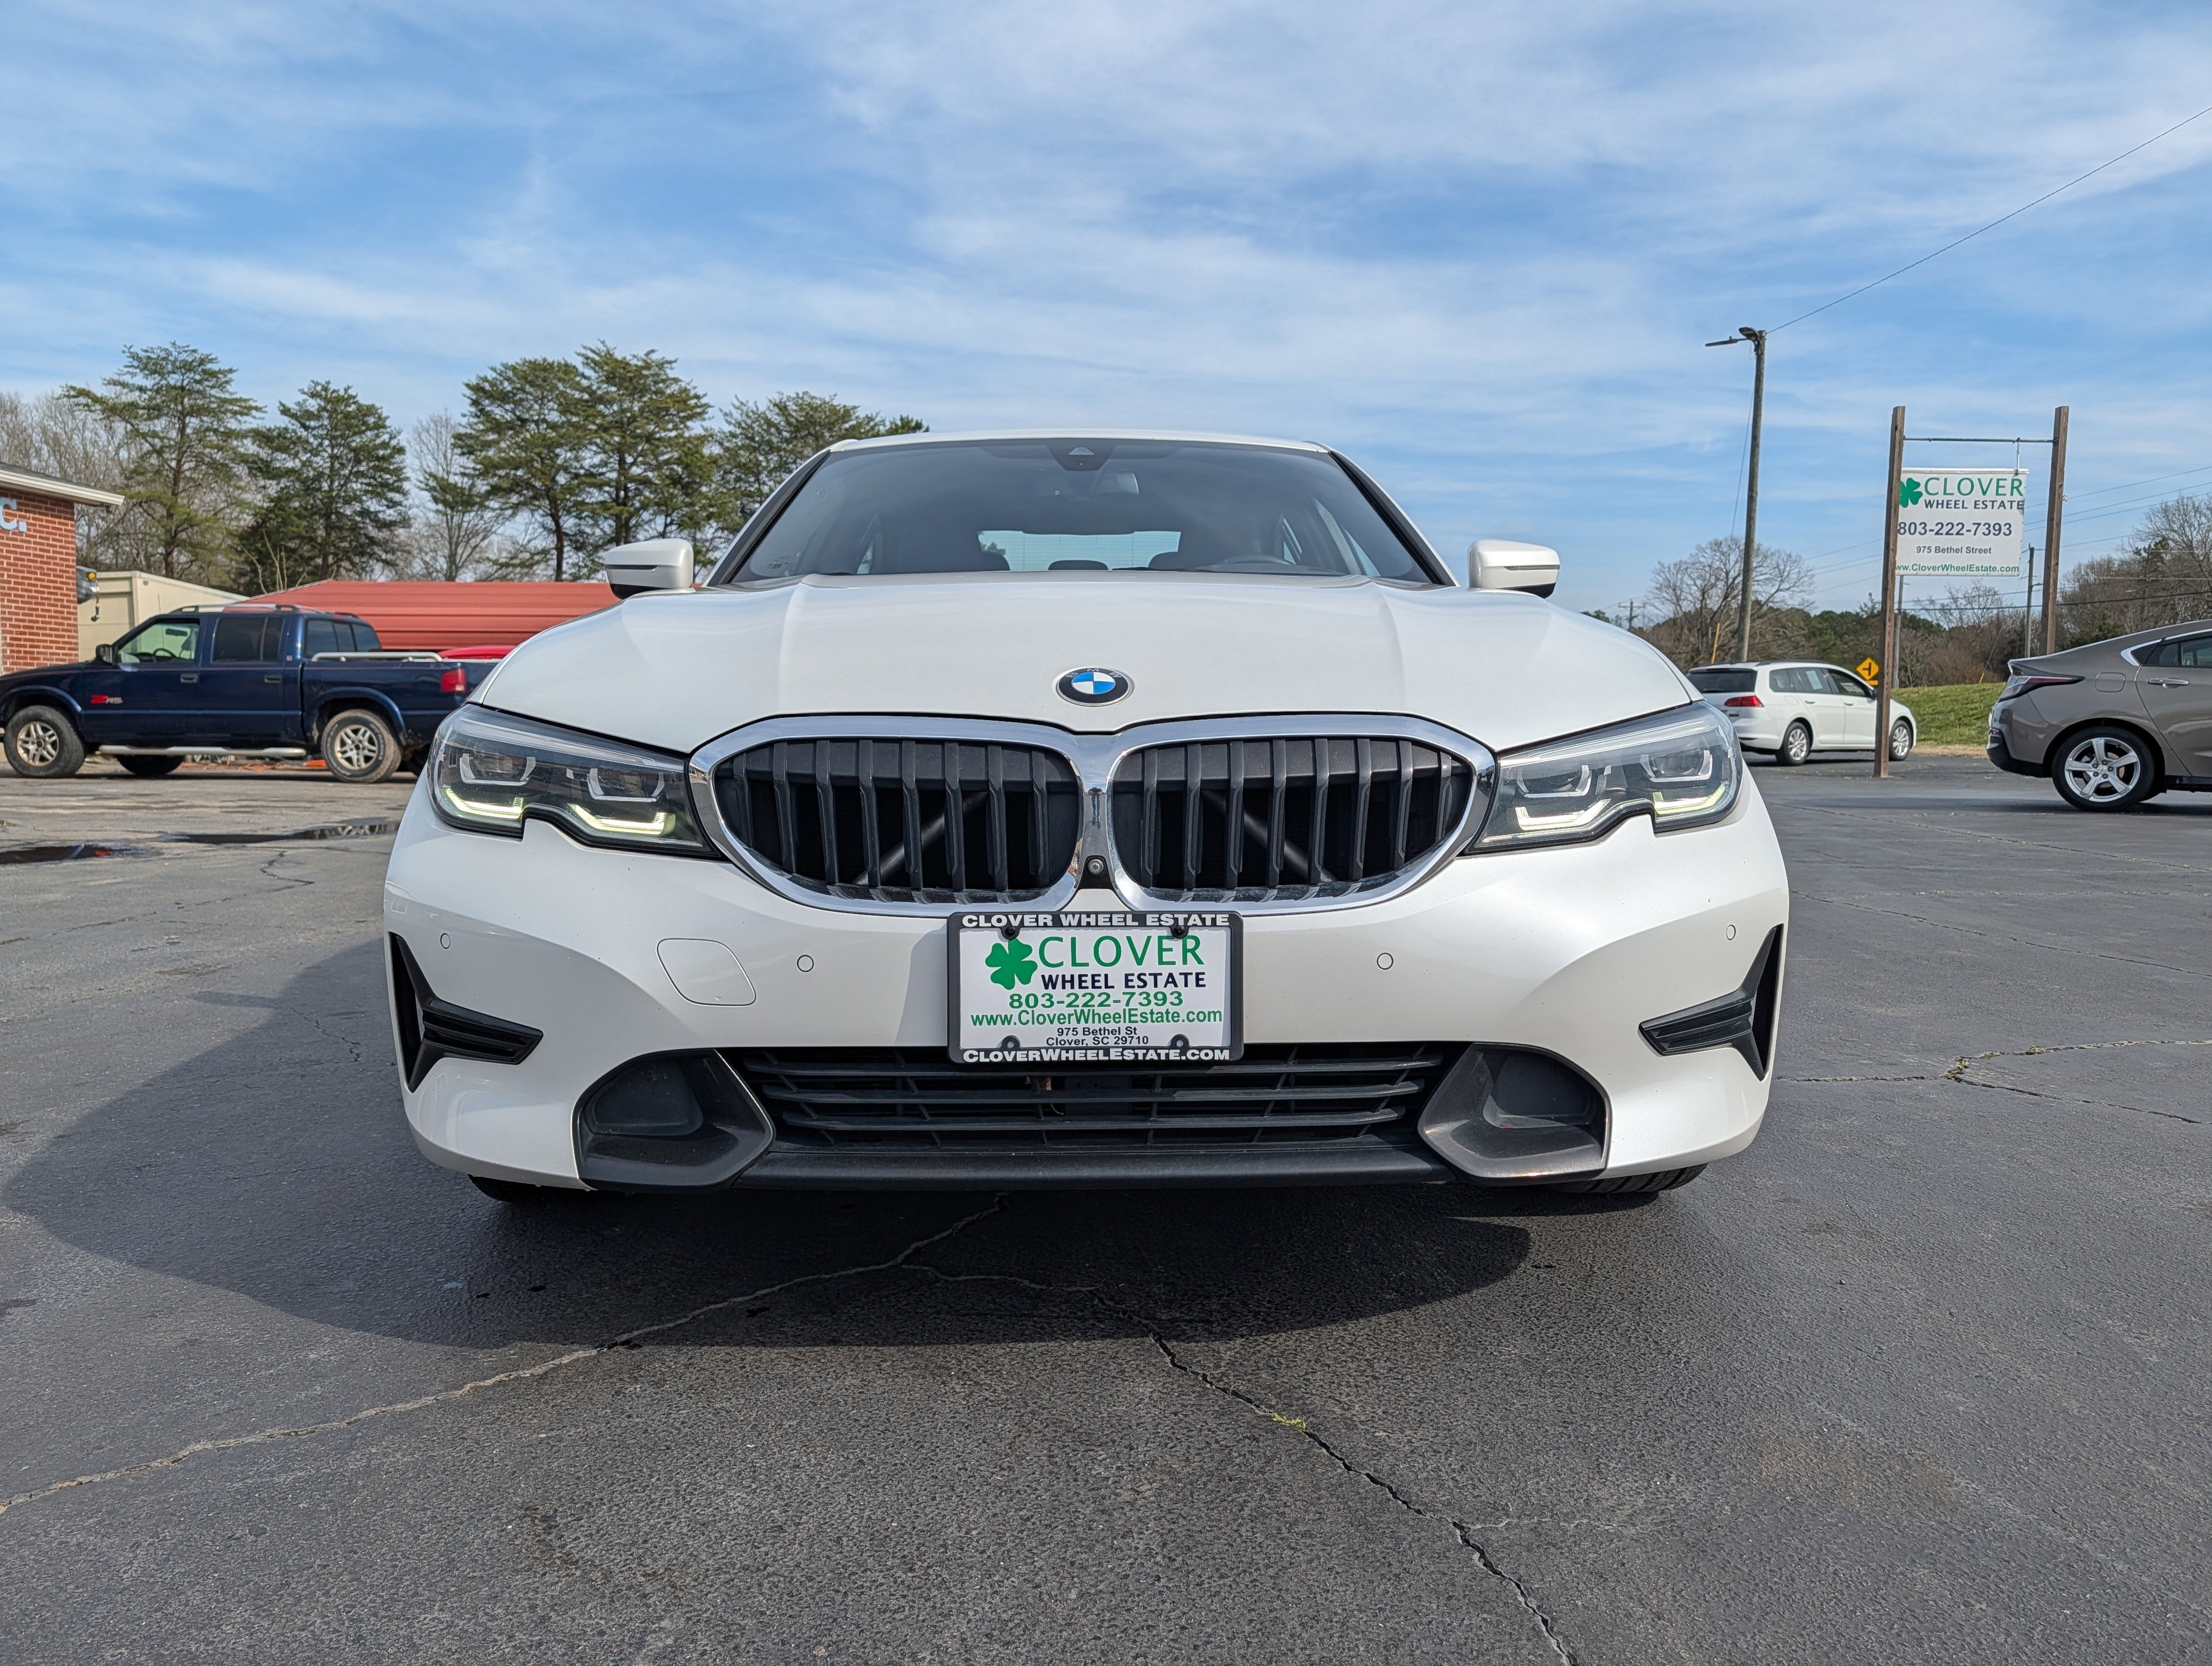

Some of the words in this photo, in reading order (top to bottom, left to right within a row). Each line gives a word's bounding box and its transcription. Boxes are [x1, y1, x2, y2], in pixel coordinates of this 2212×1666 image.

[1924, 477, 2023, 496] CLOVER
[1924, 499, 1968, 509] WHEEL
[1973, 500, 2024, 510] ESTATE
[1898, 522, 2012, 536] 803-222-7393
[1896, 563, 2019, 572] ww.CloverWheelEstate.com
[1066, 668, 1122, 678] BMW
[962, 914, 1053, 927] CLOVER
[1059, 914, 1139, 926] WHEEL
[1146, 914, 1230, 926] ESTATE
[1038, 935, 1205, 968] CLOVER
[1041, 973, 1115, 990] WHEEL
[1124, 972, 1206, 988] ESTATE
[1008, 991, 1184, 1009] 803-222-7393
[970, 1008, 1223, 1027] www.CloverWheelEstate.com
[1057, 1027, 1078, 1036] 975
[1083, 1026, 1121, 1036] Bethel
[1125, 1026, 1137, 1035] St
[1046, 1037, 1089, 1047] Clover,
[1092, 1037, 1109, 1046] SC
[1114, 1036, 1149, 1045] 29710
